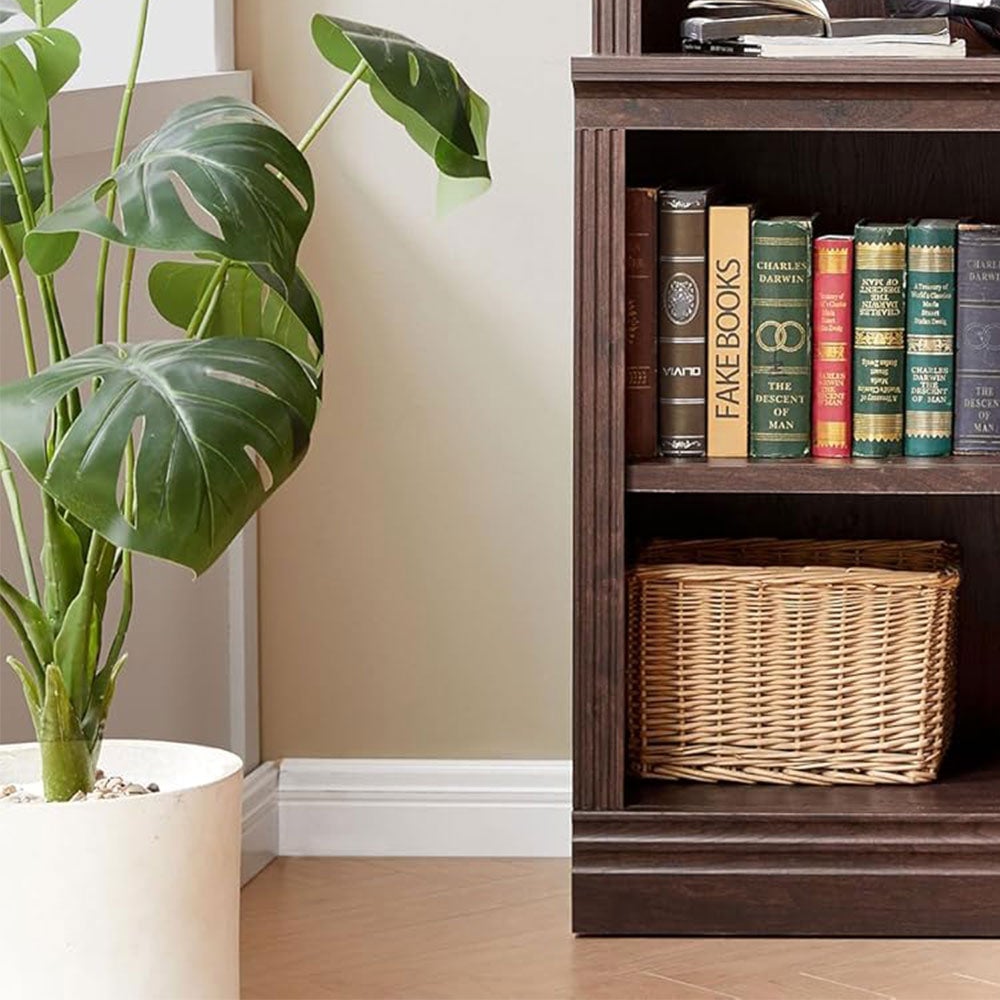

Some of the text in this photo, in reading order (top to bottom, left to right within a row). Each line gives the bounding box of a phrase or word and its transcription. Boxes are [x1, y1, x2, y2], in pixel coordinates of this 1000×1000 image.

[756, 261, 807, 272] CHARLES
[758, 273, 804, 284] DARWIN
[715, 258, 741, 419] FAKE BOOKS
[768, 381, 792, 391] THE
[975, 387, 994, 396] THE
[756, 394, 806, 405] DESCENT
[773, 407, 789, 417] OF
[978, 411, 992, 420] OF
[768, 420, 795, 430] MAN
[974, 423, 994, 432] MAN
